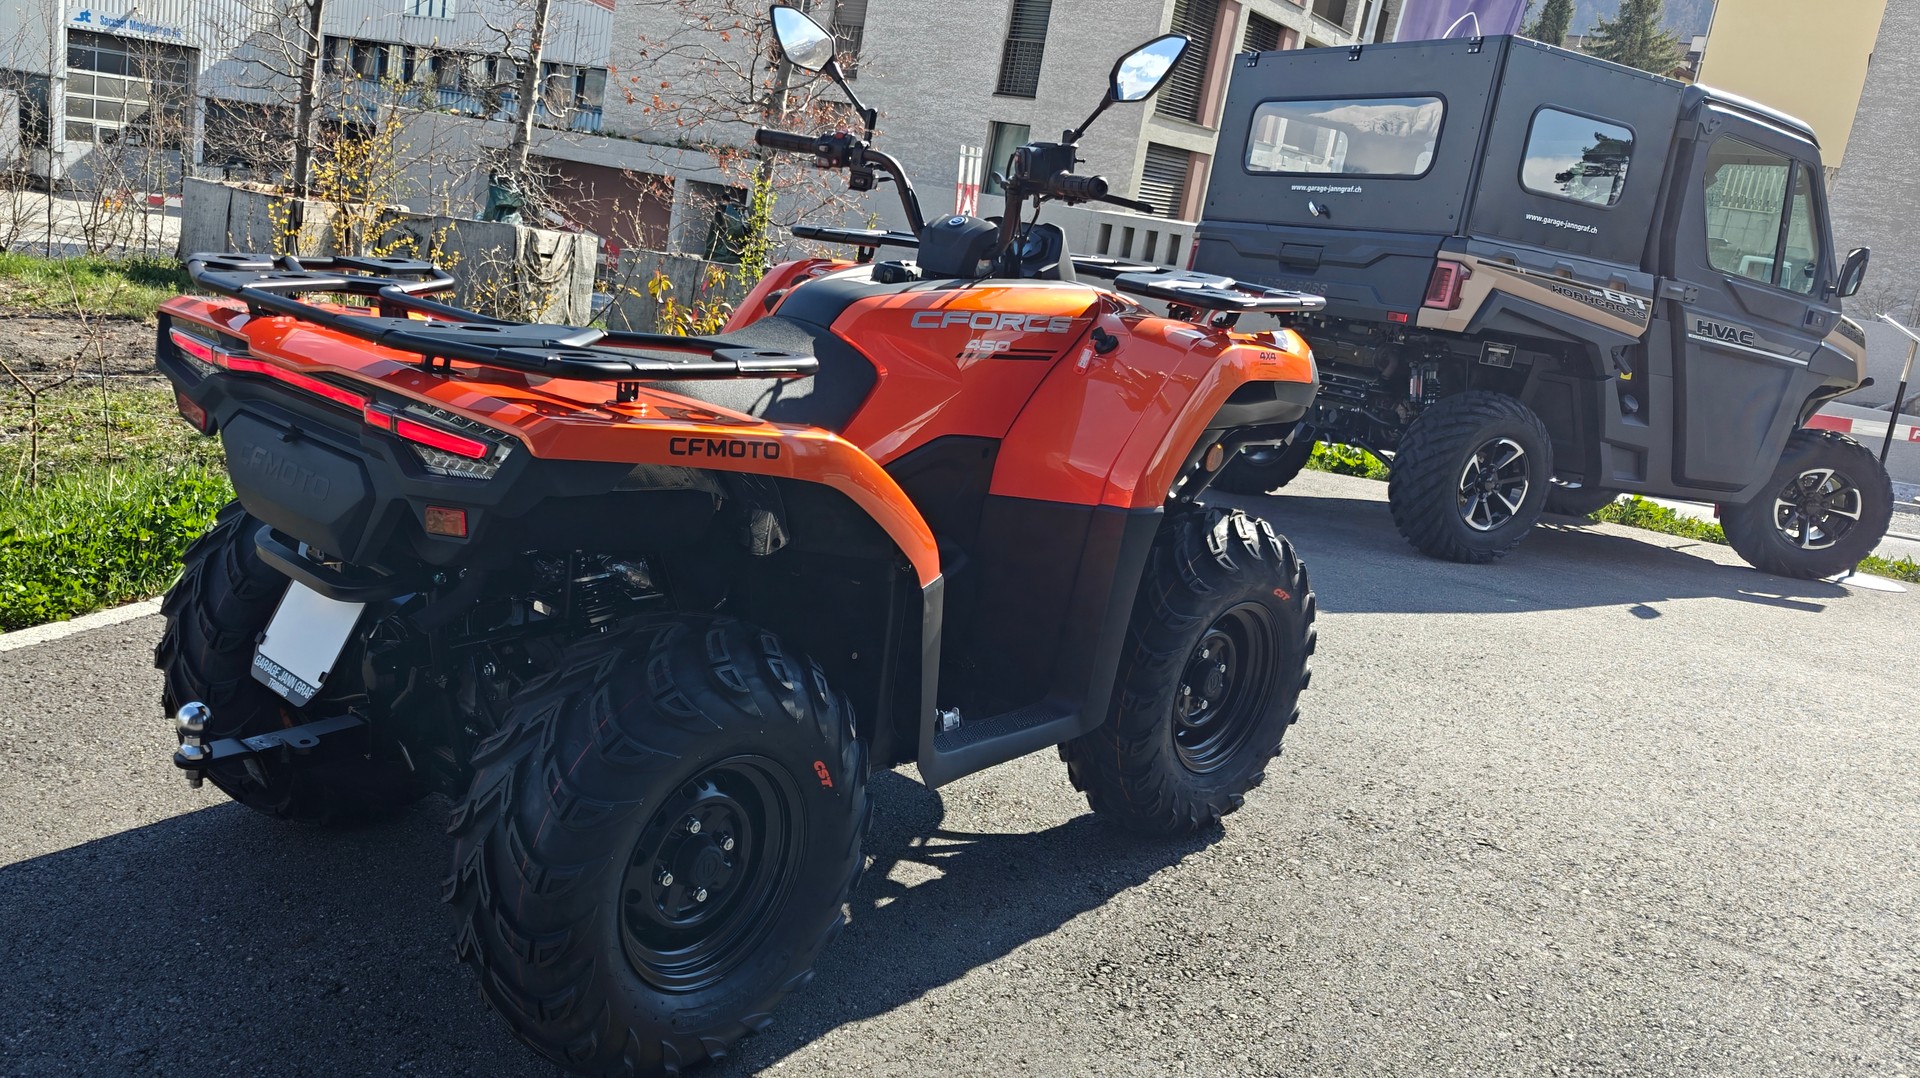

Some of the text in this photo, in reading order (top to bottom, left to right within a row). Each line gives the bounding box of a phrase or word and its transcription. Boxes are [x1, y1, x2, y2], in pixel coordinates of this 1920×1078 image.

[1291, 184, 1362, 194] www.garage-janngraf.ch
[1525, 213, 1598, 234] www.garage-janngraf.ch
[911, 311, 1073, 333] CFORCE
[1696, 319, 1755, 346] HVAC
[965, 339, 1011, 352] 450
[669, 437, 780, 460] CFMOTO
[240, 442, 331, 502] CFMOTO
[1273, 588, 1291, 601] CST
[254, 654, 315, 699] GARAGE JANN GRAF
[813, 760, 833, 787] CST
